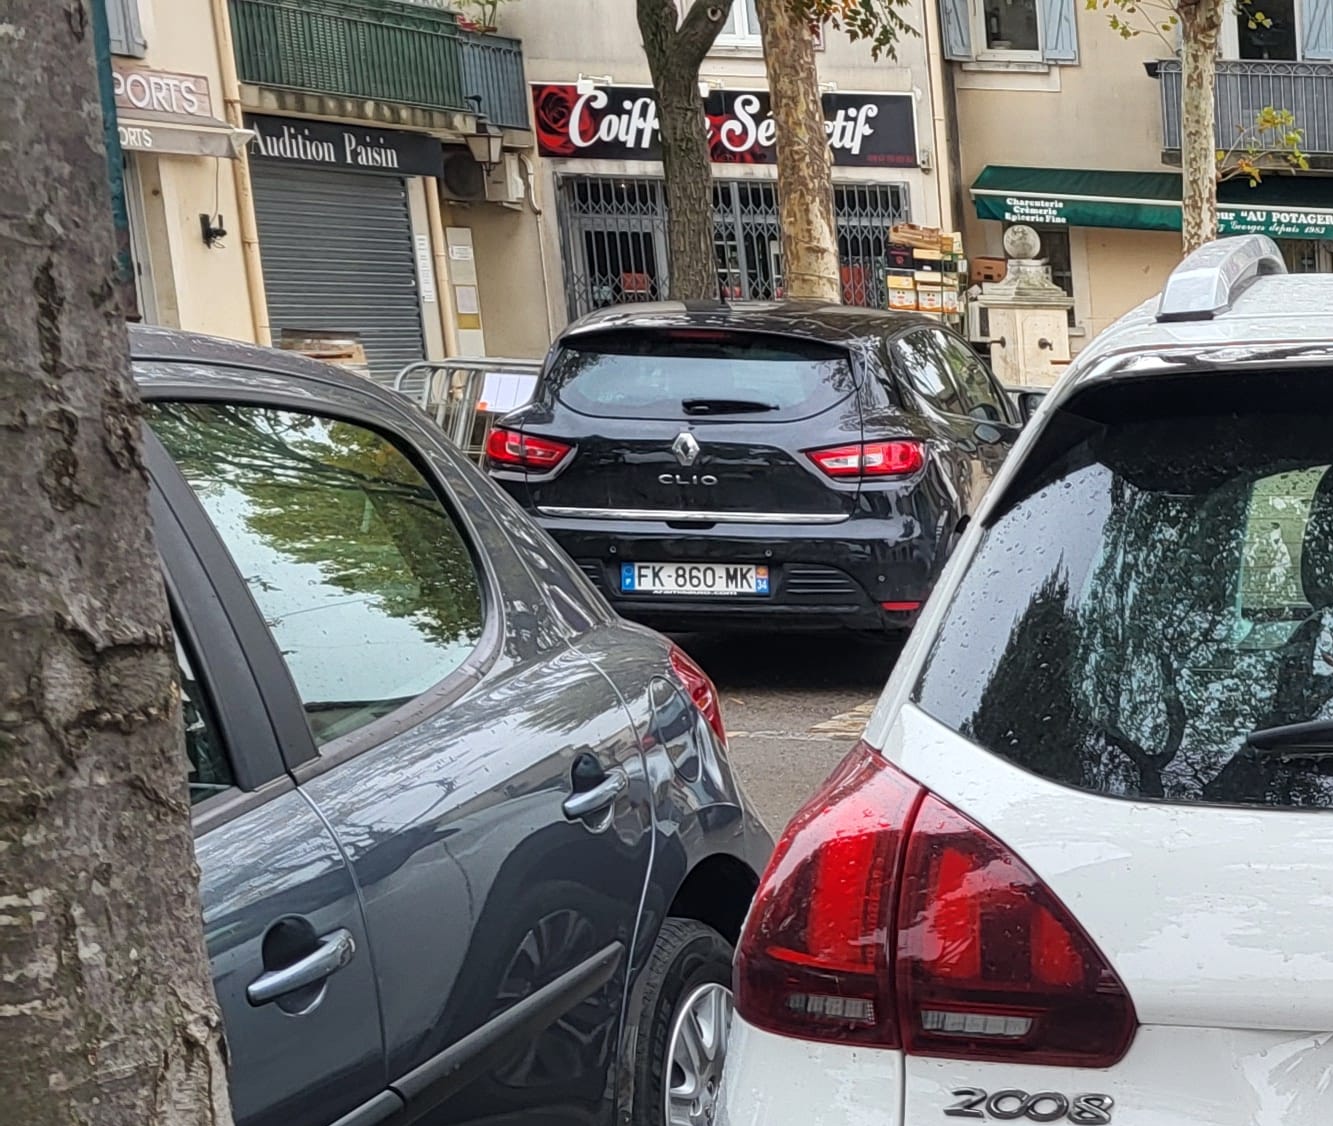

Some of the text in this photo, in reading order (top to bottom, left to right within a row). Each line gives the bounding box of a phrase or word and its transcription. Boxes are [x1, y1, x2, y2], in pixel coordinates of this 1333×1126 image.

[111, 71, 198, 113] PORTS
[568, 90, 878, 155] Coiffe Séctif
[117, 126, 153, 147] ORTS
[250, 121, 399, 168] Audition Paisin
[1006, 197, 1064, 208] Charcuterie
[1216, 211, 1235, 220] eur
[658, 473, 718, 486] CLIO
[637, 565, 753, 589] FK-860-MK
[757, 579, 768, 589] 34
[943, 1086, 1115, 1126] 2008
